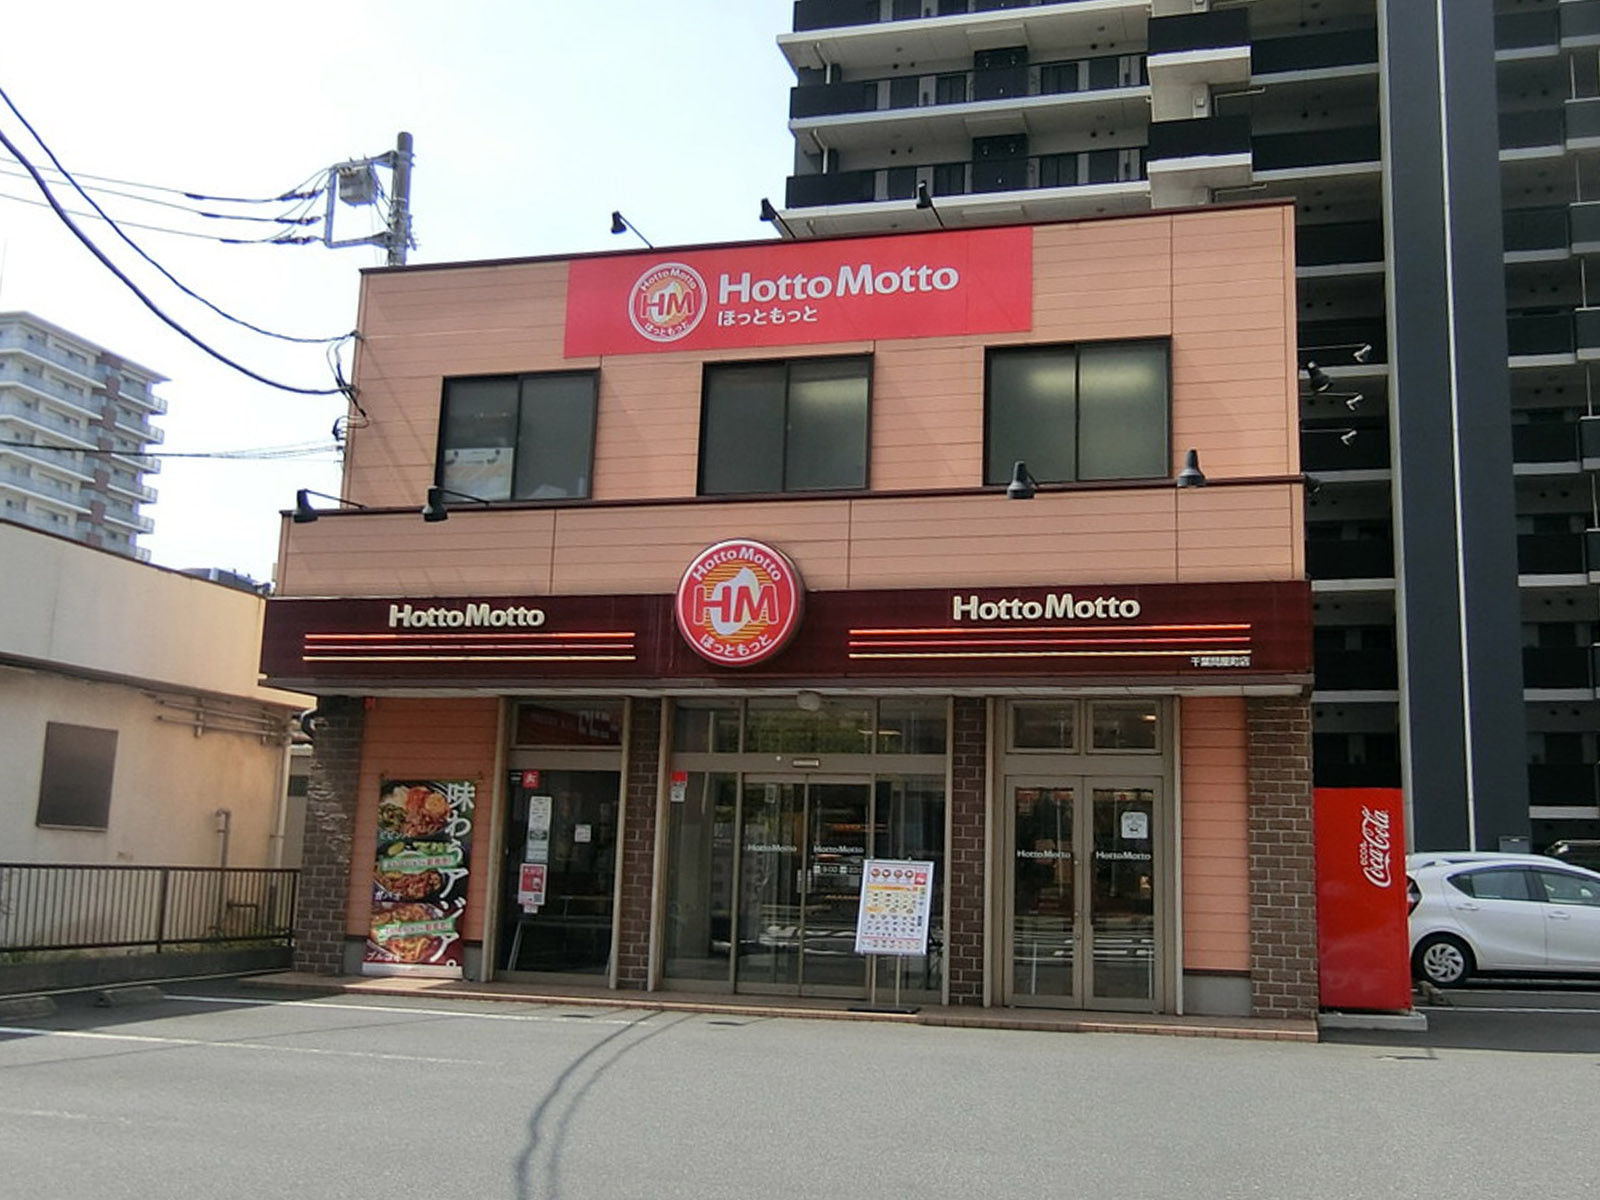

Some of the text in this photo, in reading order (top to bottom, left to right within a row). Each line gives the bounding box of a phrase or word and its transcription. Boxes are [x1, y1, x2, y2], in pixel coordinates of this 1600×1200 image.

[718, 305, 818, 327] ほっともっと
[693, 584, 780, 626] HM
[700, 634, 772, 657] ほっともっと
[1361, 805, 1391, 888] Coca-Cola
